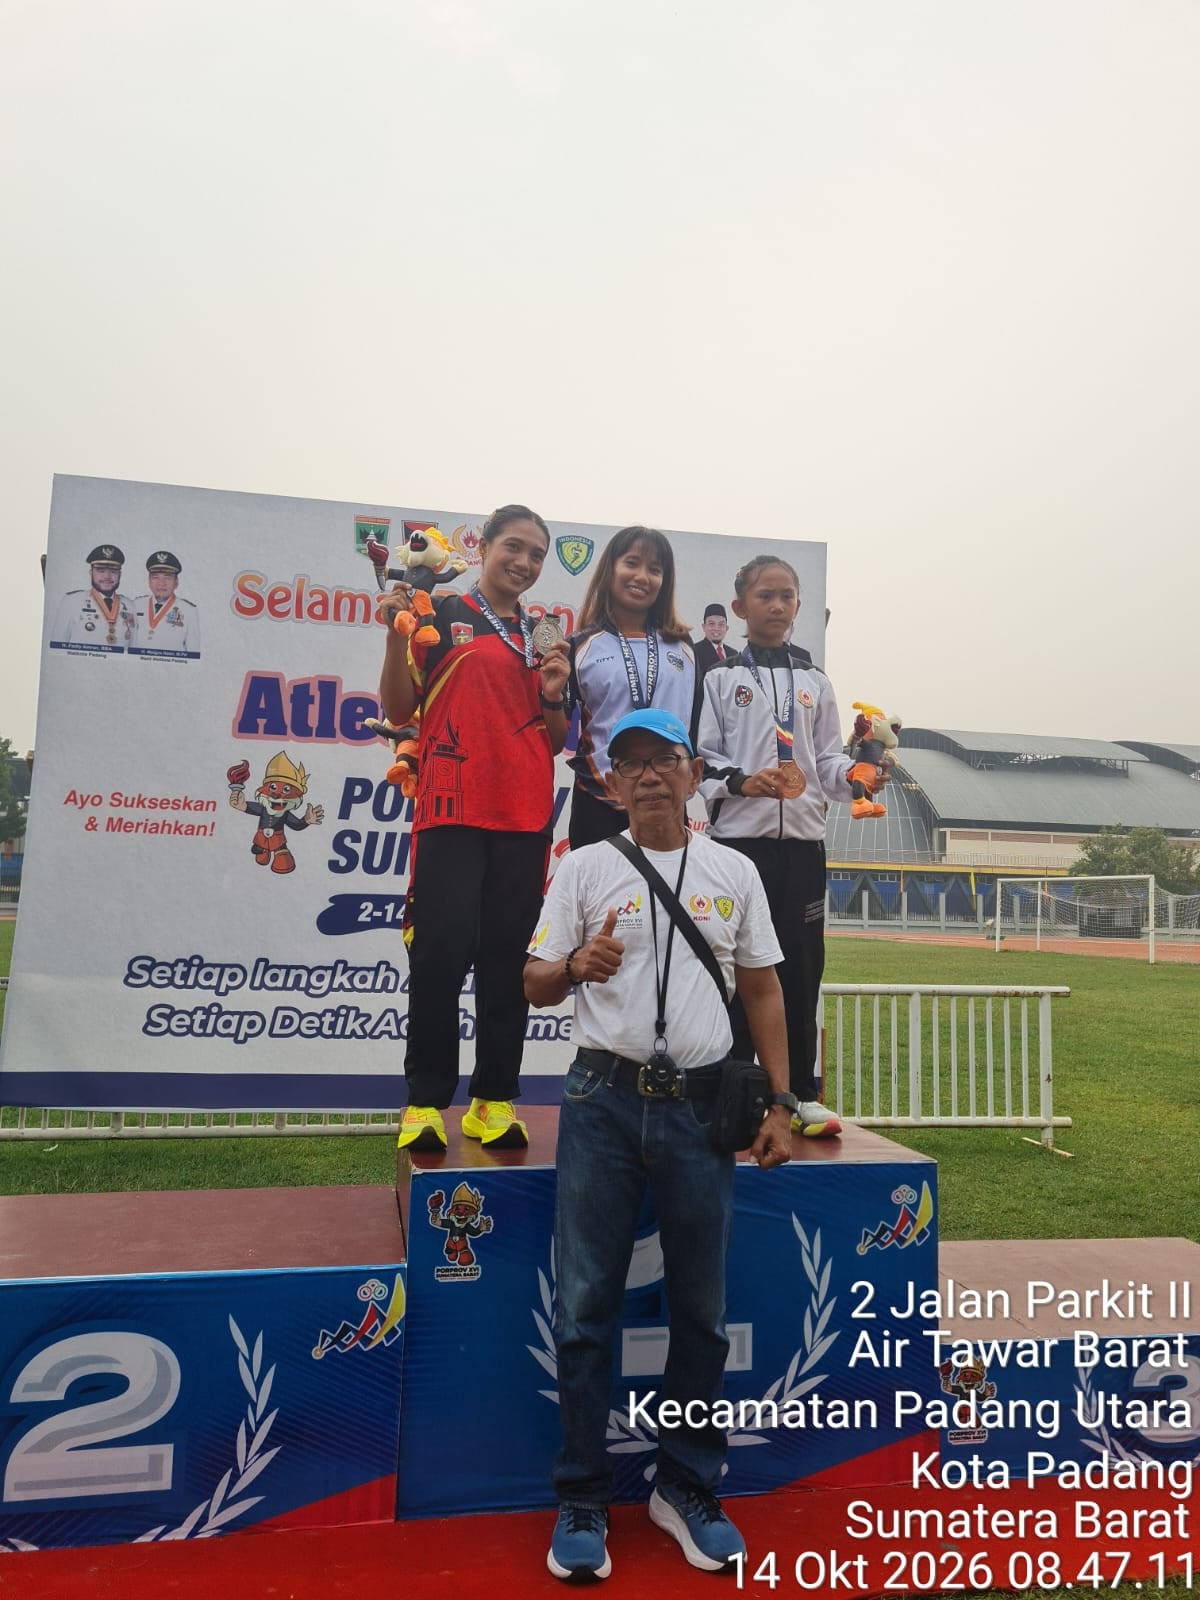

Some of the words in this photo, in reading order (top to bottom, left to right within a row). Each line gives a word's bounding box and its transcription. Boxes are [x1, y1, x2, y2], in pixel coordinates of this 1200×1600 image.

[235, 673, 386, 742] Atle
[64, 790, 103, 812] Ayo
[109, 792, 217, 813] Sukseskan
[84, 817, 99, 832] &
[105, 817, 215, 837] Meriahkan!
[126, 957, 245, 995] Setiap
[252, 958, 399, 997] langkah
[143, 1004, 264, 1043] Setiap
[270, 1006, 370, 1039] Detik
[3, 1331, 182, 1501] 2
